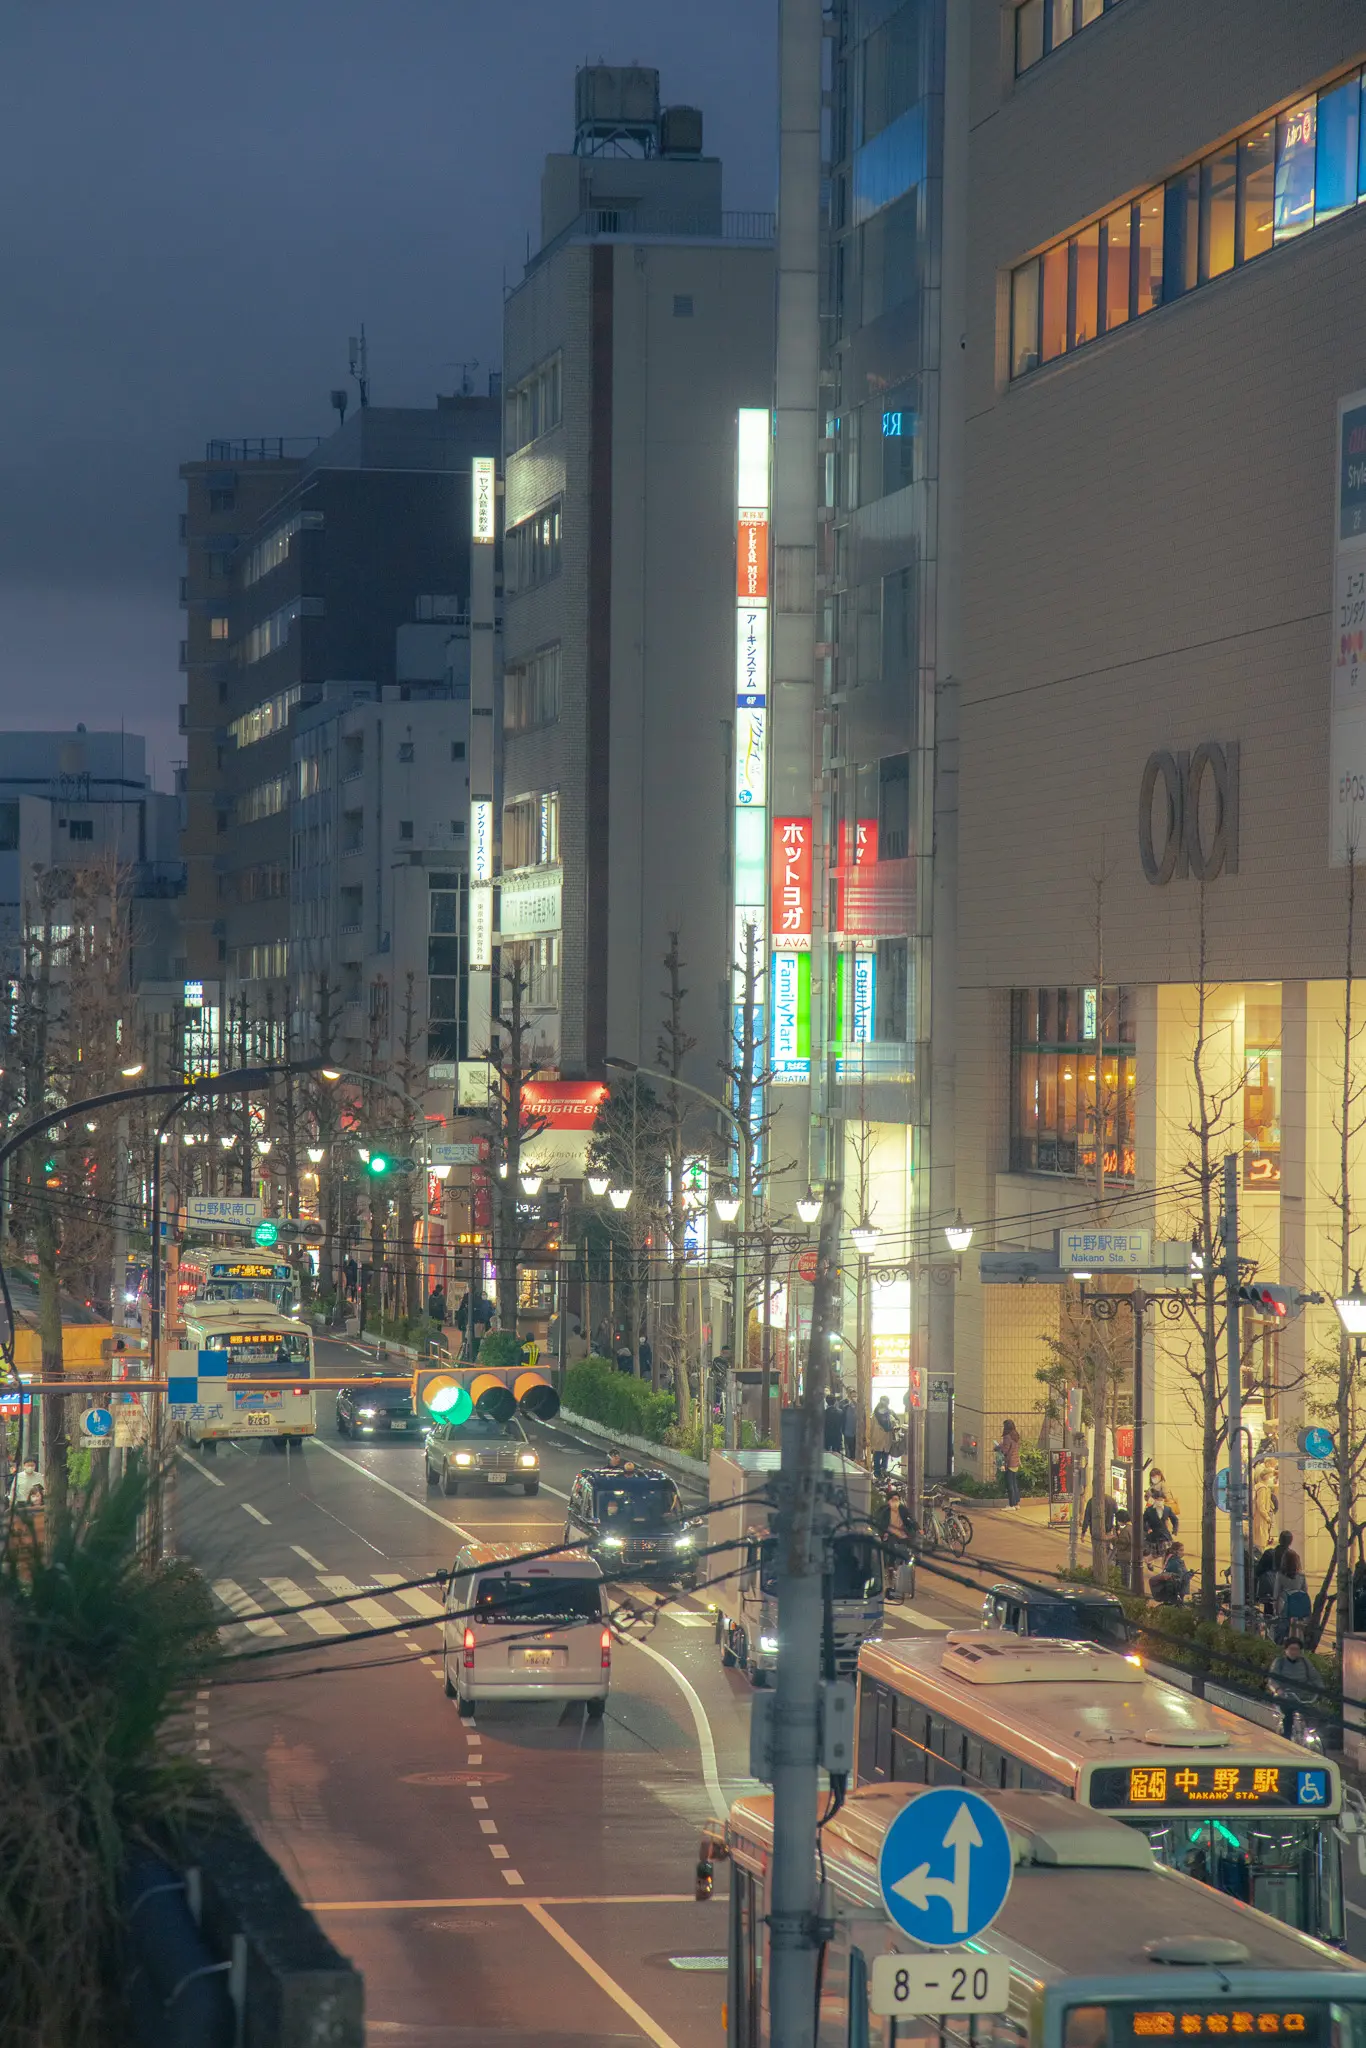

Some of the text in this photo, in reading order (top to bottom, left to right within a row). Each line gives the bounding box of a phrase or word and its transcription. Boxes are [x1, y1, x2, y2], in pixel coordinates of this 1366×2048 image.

[478, 477, 489, 533] ヤマハ音楽教室
[747, 527, 758, 594] CLEAR MODE
[746, 614, 757, 688] アーキシステム
[746, 696, 756, 705] 6F
[477, 804, 486, 880] インクリースヘアー
[782, 823, 804, 929] ホットヨガ
[476, 903, 484, 961] 東京中央美容外科
[775, 938, 809, 947] LAVA
[777, 959, 795, 1052] FamilyMart
[194, 1202, 256, 1216] 中野駅南口
[1067, 1234, 1142, 1251] 中野駅南口
[1071, 1253, 1105, 1262] Nakano
[1109, 1253, 1126, 1263] Sta.
[171, 1404, 224, 1421] 時差式
[1175, 1768, 1278, 1793] 中野駅
[1189, 1792, 1259, 1800] NAKANO STA.
